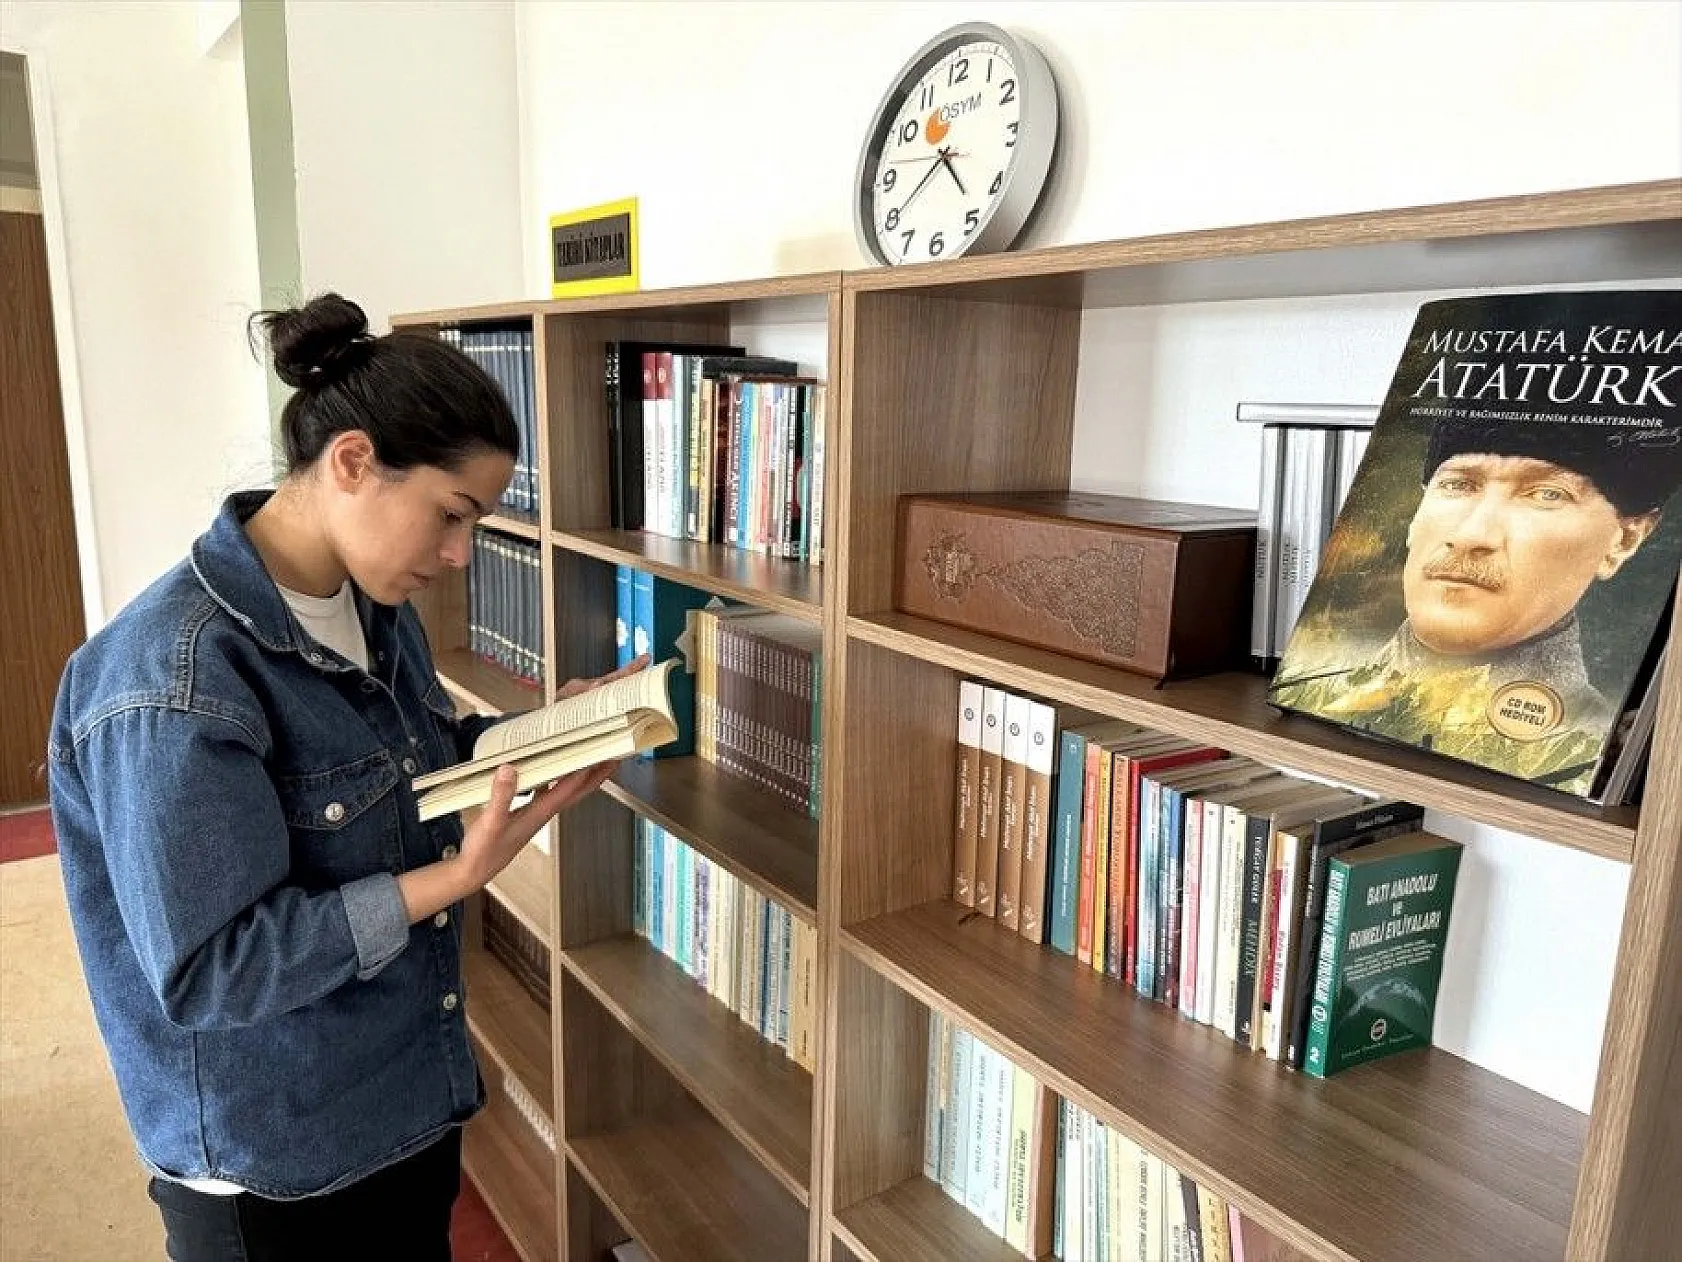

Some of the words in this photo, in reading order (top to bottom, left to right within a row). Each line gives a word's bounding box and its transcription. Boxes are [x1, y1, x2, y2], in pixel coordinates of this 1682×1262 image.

[948, 58, 969, 87] 12
[986, 58, 992, 83] 1
[920, 84, 934, 111] 11
[999, 78, 1016, 105] 2
[898, 119, 919, 147] 10
[1004, 121, 1019, 147] 3
[883, 168, 897, 193] 9
[988, 171, 1004, 195] 4
[884, 207, 900, 232] 8
[964, 208, 980, 236] 5
[901, 229, 915, 256] 7
[929, 232, 944, 257] 6
[1423, 329, 1566, 353] MUSTAFA
[1410, 355, 1682, 407] ATATÜRK
[1506, 697, 1522, 708] CD
[1309, 1046, 1321, 1063] 2
